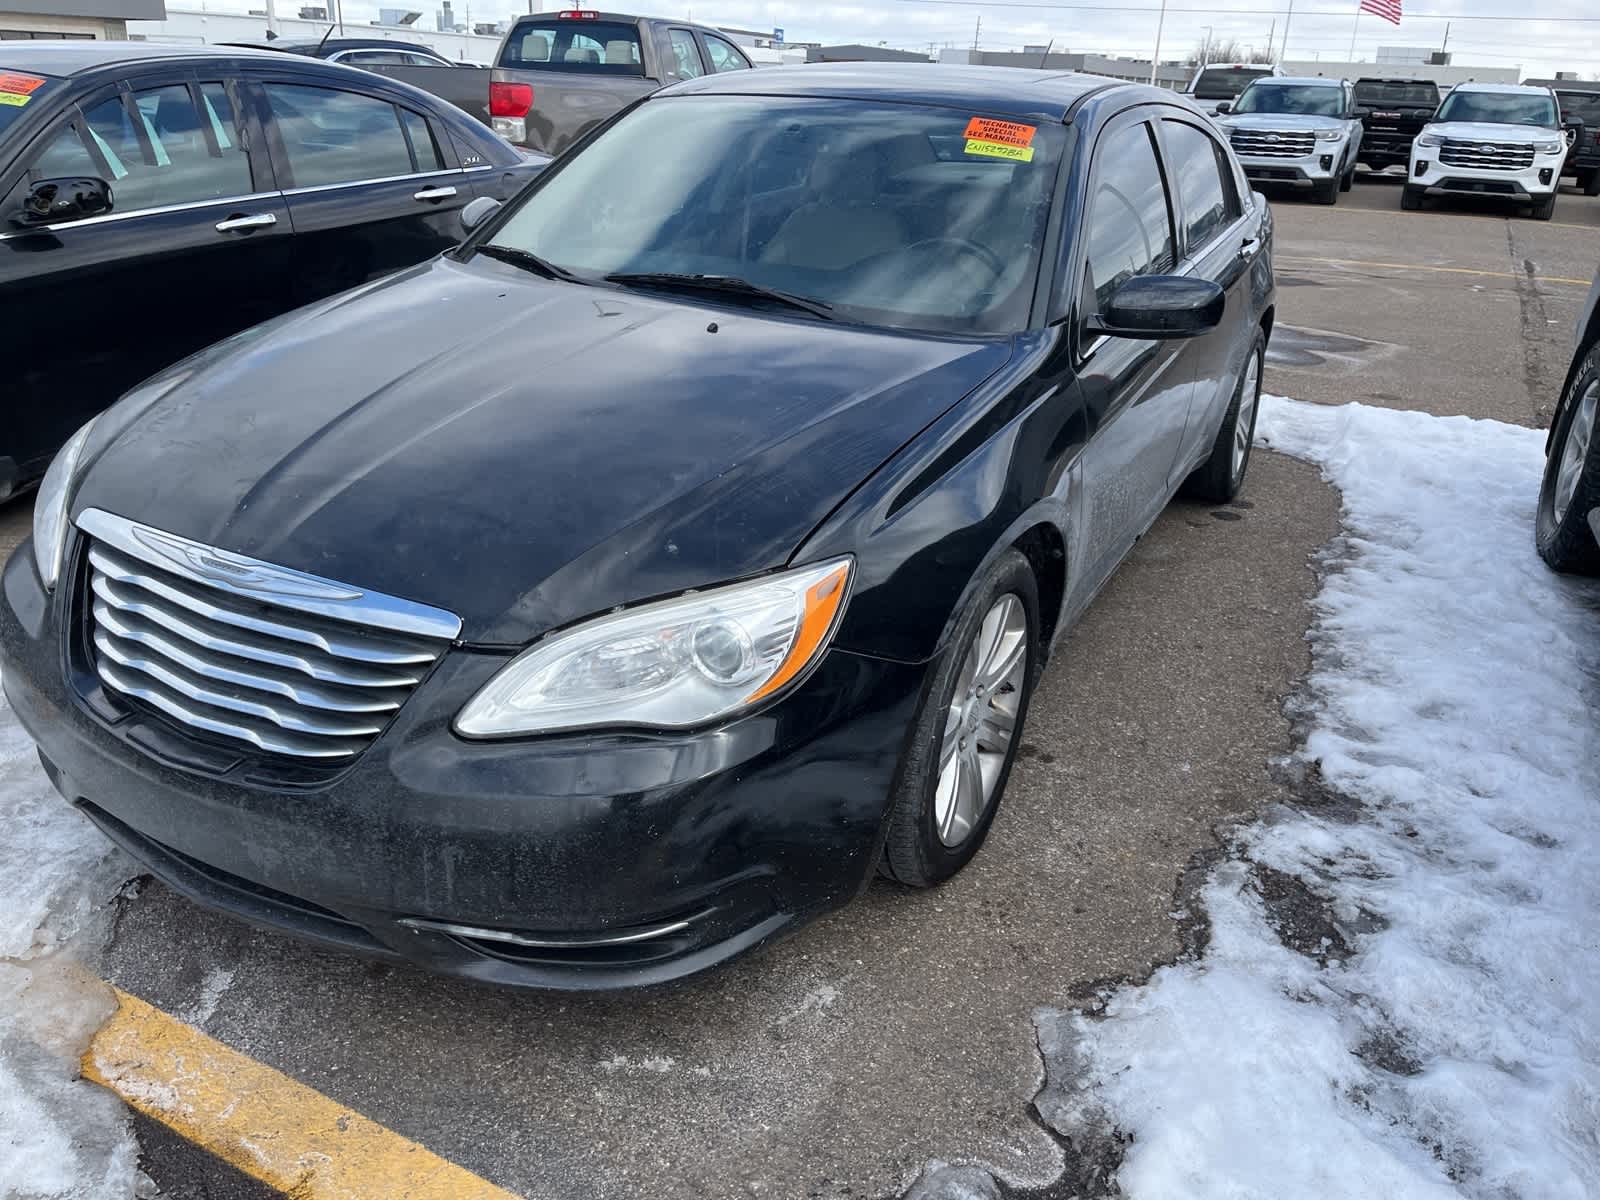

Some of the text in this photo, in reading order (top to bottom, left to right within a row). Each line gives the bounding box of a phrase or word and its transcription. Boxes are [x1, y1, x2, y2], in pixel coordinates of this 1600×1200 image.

[978, 120, 1027, 132] MECHANICS
[983, 127, 1016, 137] SPECIAL
[985, 133, 1028, 145] MANAGER
